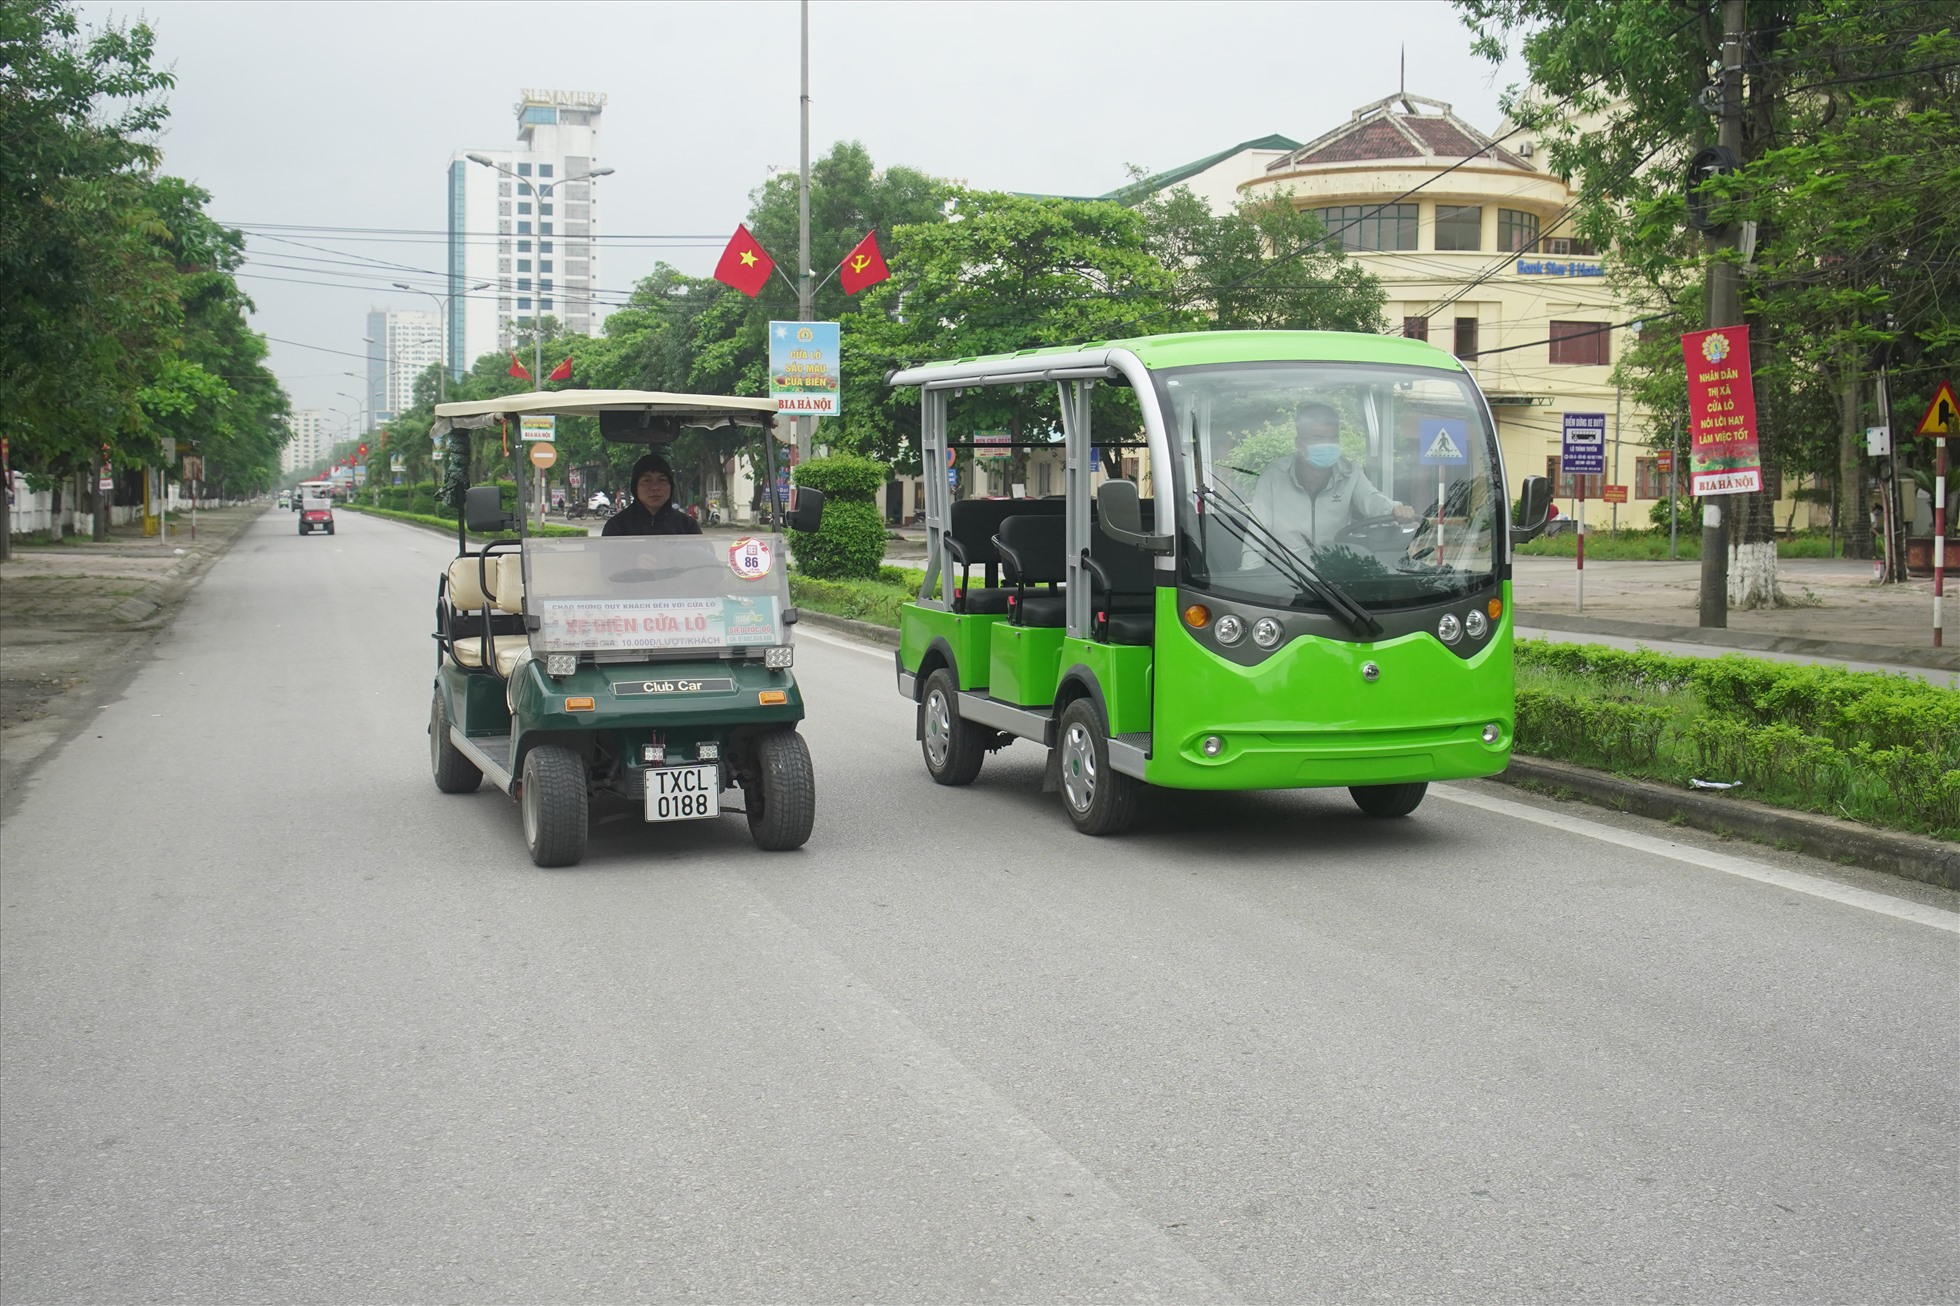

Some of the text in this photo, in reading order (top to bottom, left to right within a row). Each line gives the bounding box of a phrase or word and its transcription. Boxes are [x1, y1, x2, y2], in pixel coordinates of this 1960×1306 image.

[520, 88, 598, 105] SUMMER
[1517, 259, 1542, 275] Bank
[1545, 261, 1566, 276] Star
[1699, 369, 1738, 383] NHÂN DÂN
[1707, 387, 1719, 399] THỊ
[778, 397, 831, 412] BIA HÀ NỘI
[1707, 399, 1734, 413] CỬA LÒ
[1701, 415, 1744, 429] NÓI LỜI HAY
[1699, 427, 1748, 445] LÀM VIỆC TỐT
[1699, 475, 1754, 491] BIA HÀ NỘI
[744, 556, 759, 568] 86
[643, 612, 680, 633] CỬA
[685, 613, 706, 631] LÒ
[643, 680, 702, 692] Club Car
[656, 769, 708, 794] TXCL
[658, 794, 707, 818] 0188
